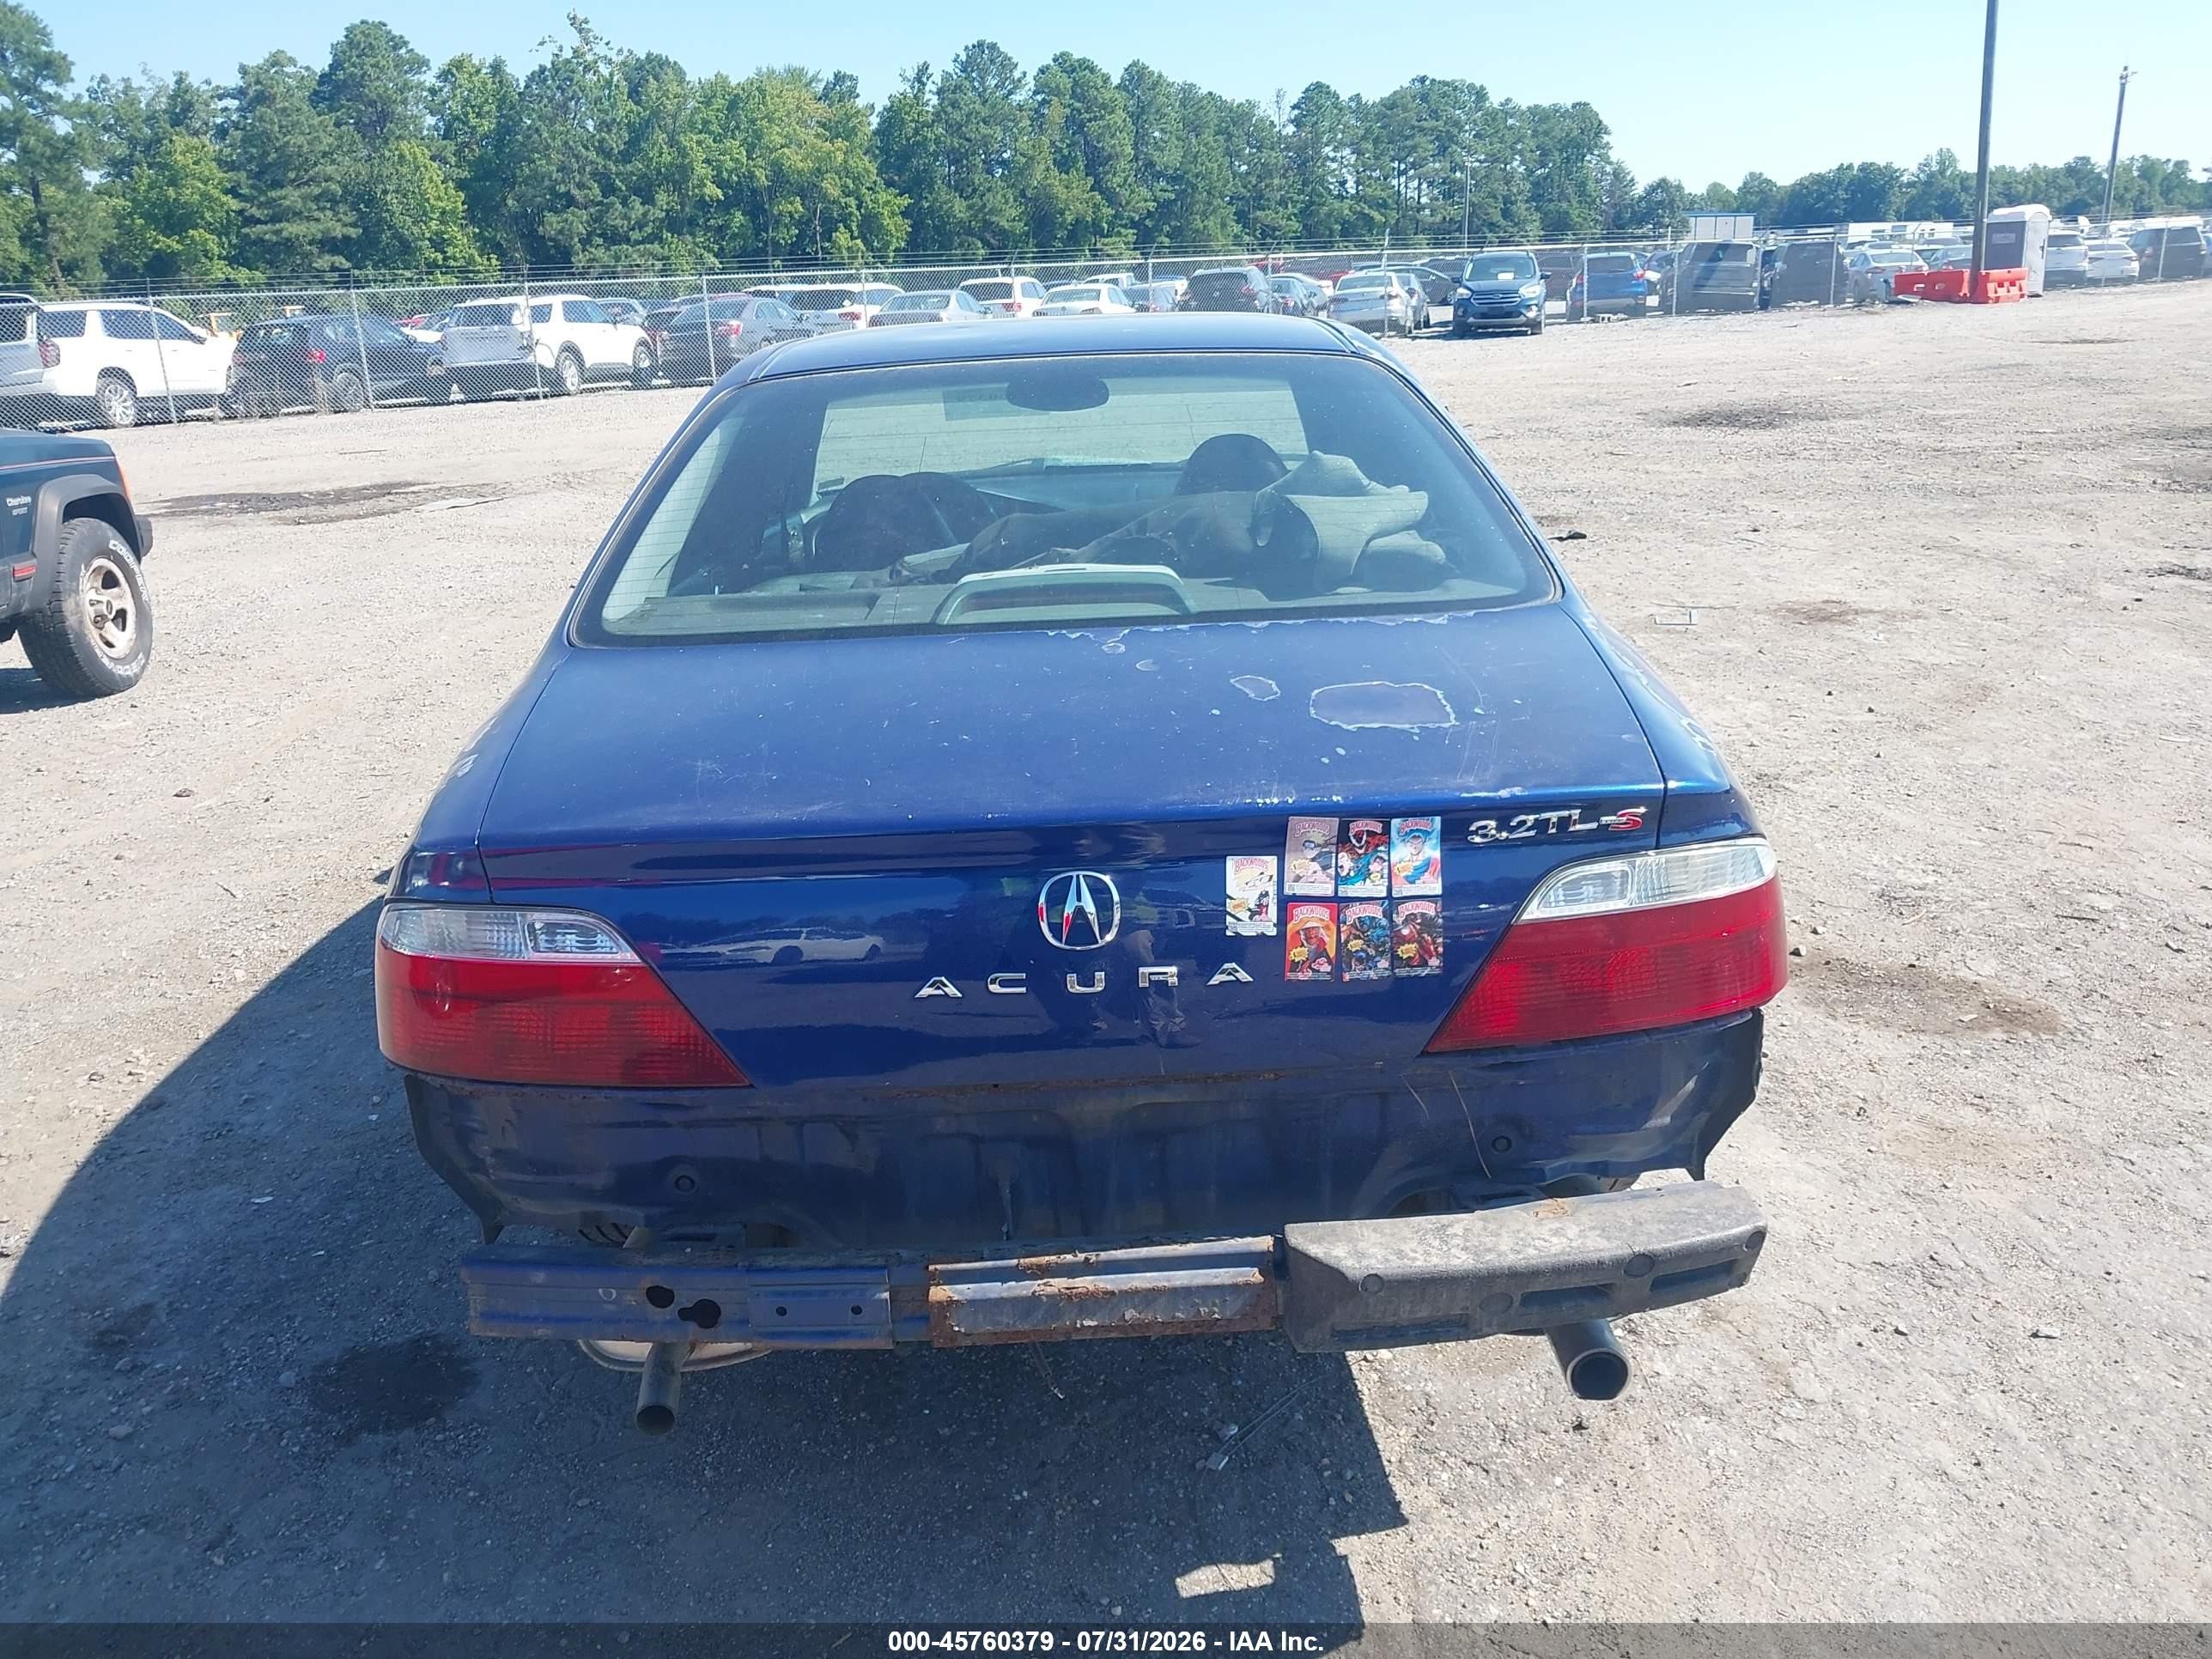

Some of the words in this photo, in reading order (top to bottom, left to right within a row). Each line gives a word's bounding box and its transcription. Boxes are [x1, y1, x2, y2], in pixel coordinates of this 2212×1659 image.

[108, 539, 149, 603] COOPER
[1295, 821, 1331, 838] BACKWOODS
[1349, 820, 1383, 836] BACKWOODS
[1399, 819, 1433, 836] BACKWOODS
[1233, 858, 1269, 875] BACKWOODS
[1292, 905, 1330, 924] BACKWOODS
[1345, 904, 1383, 925] BACKWOODS
[1398, 901, 1436, 921] BACKWOODS
[913, 961, 1254, 999] ACURA
